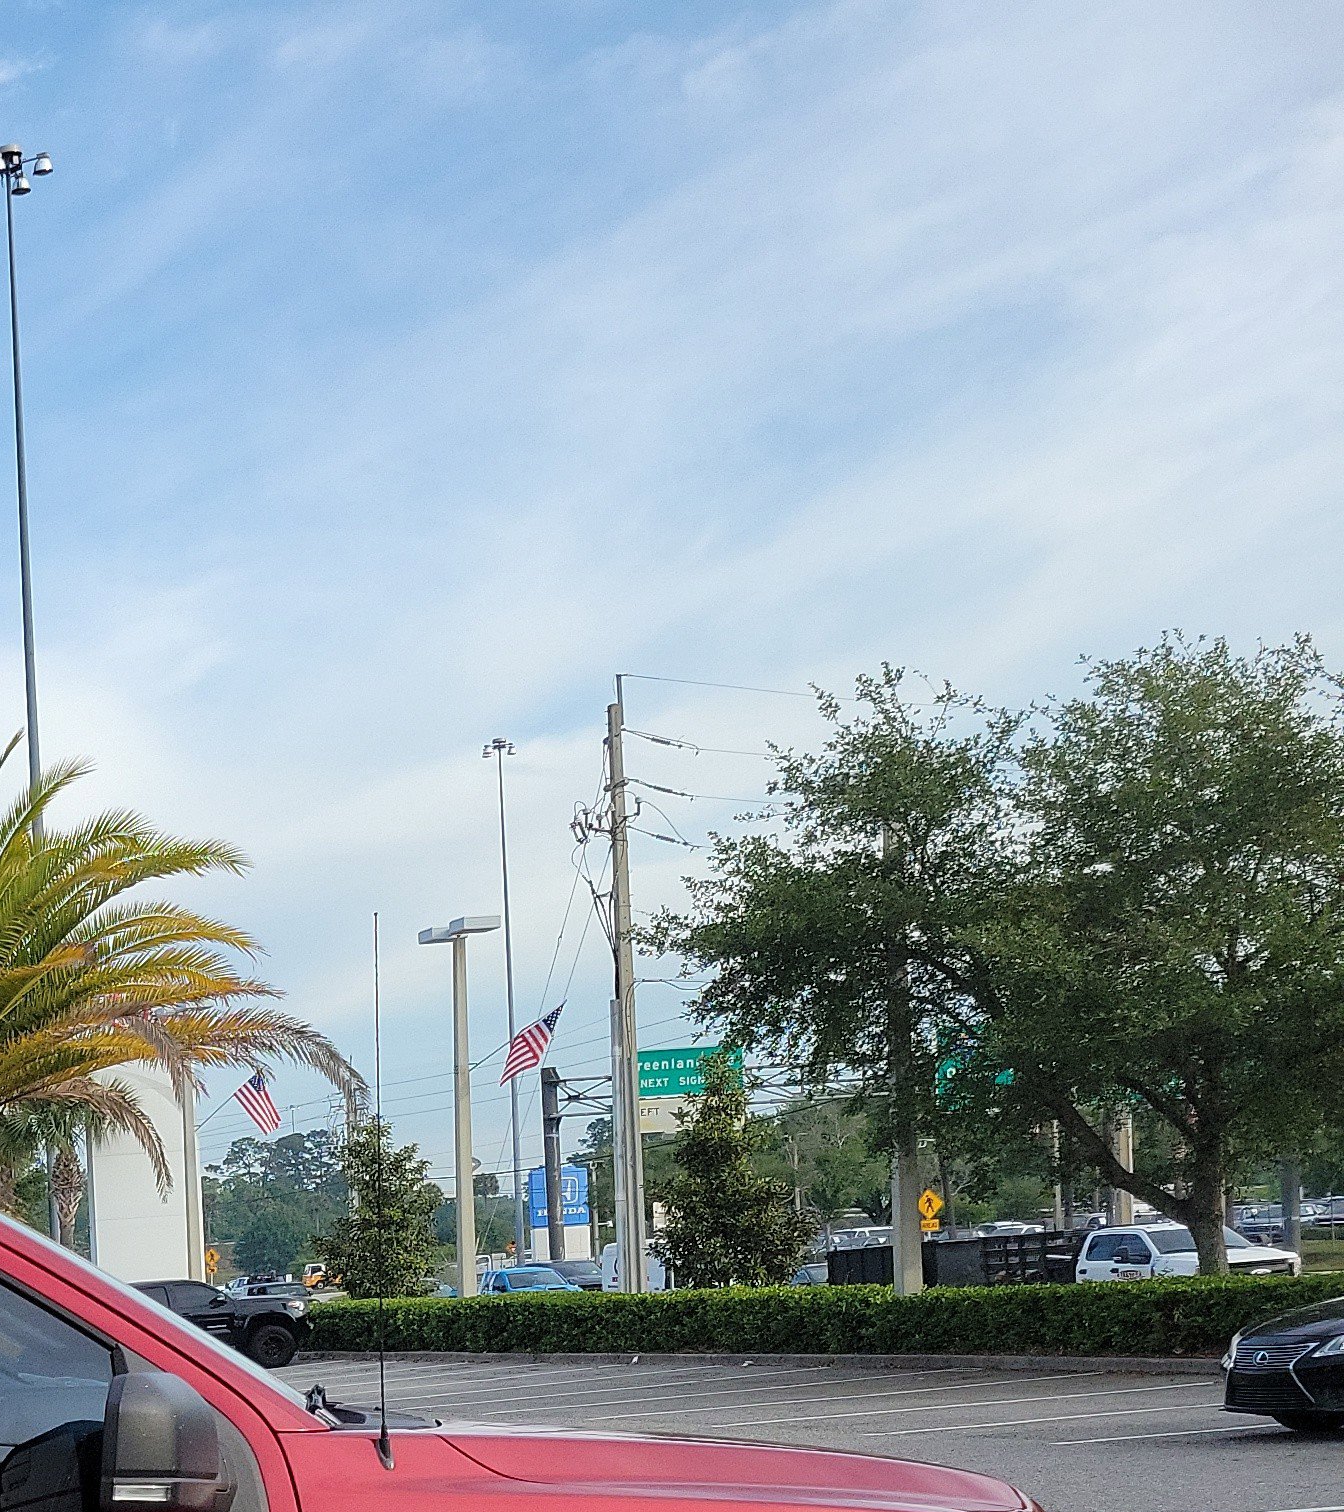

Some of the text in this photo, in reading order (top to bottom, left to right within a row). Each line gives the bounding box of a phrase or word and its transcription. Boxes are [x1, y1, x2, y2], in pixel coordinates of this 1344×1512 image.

[637, 1052, 703, 1073] reenlan
[640, 1077, 669, 1088] NEXT
[640, 1107, 660, 1117] EFT
[537, 1206, 586, 1217] HNDA
